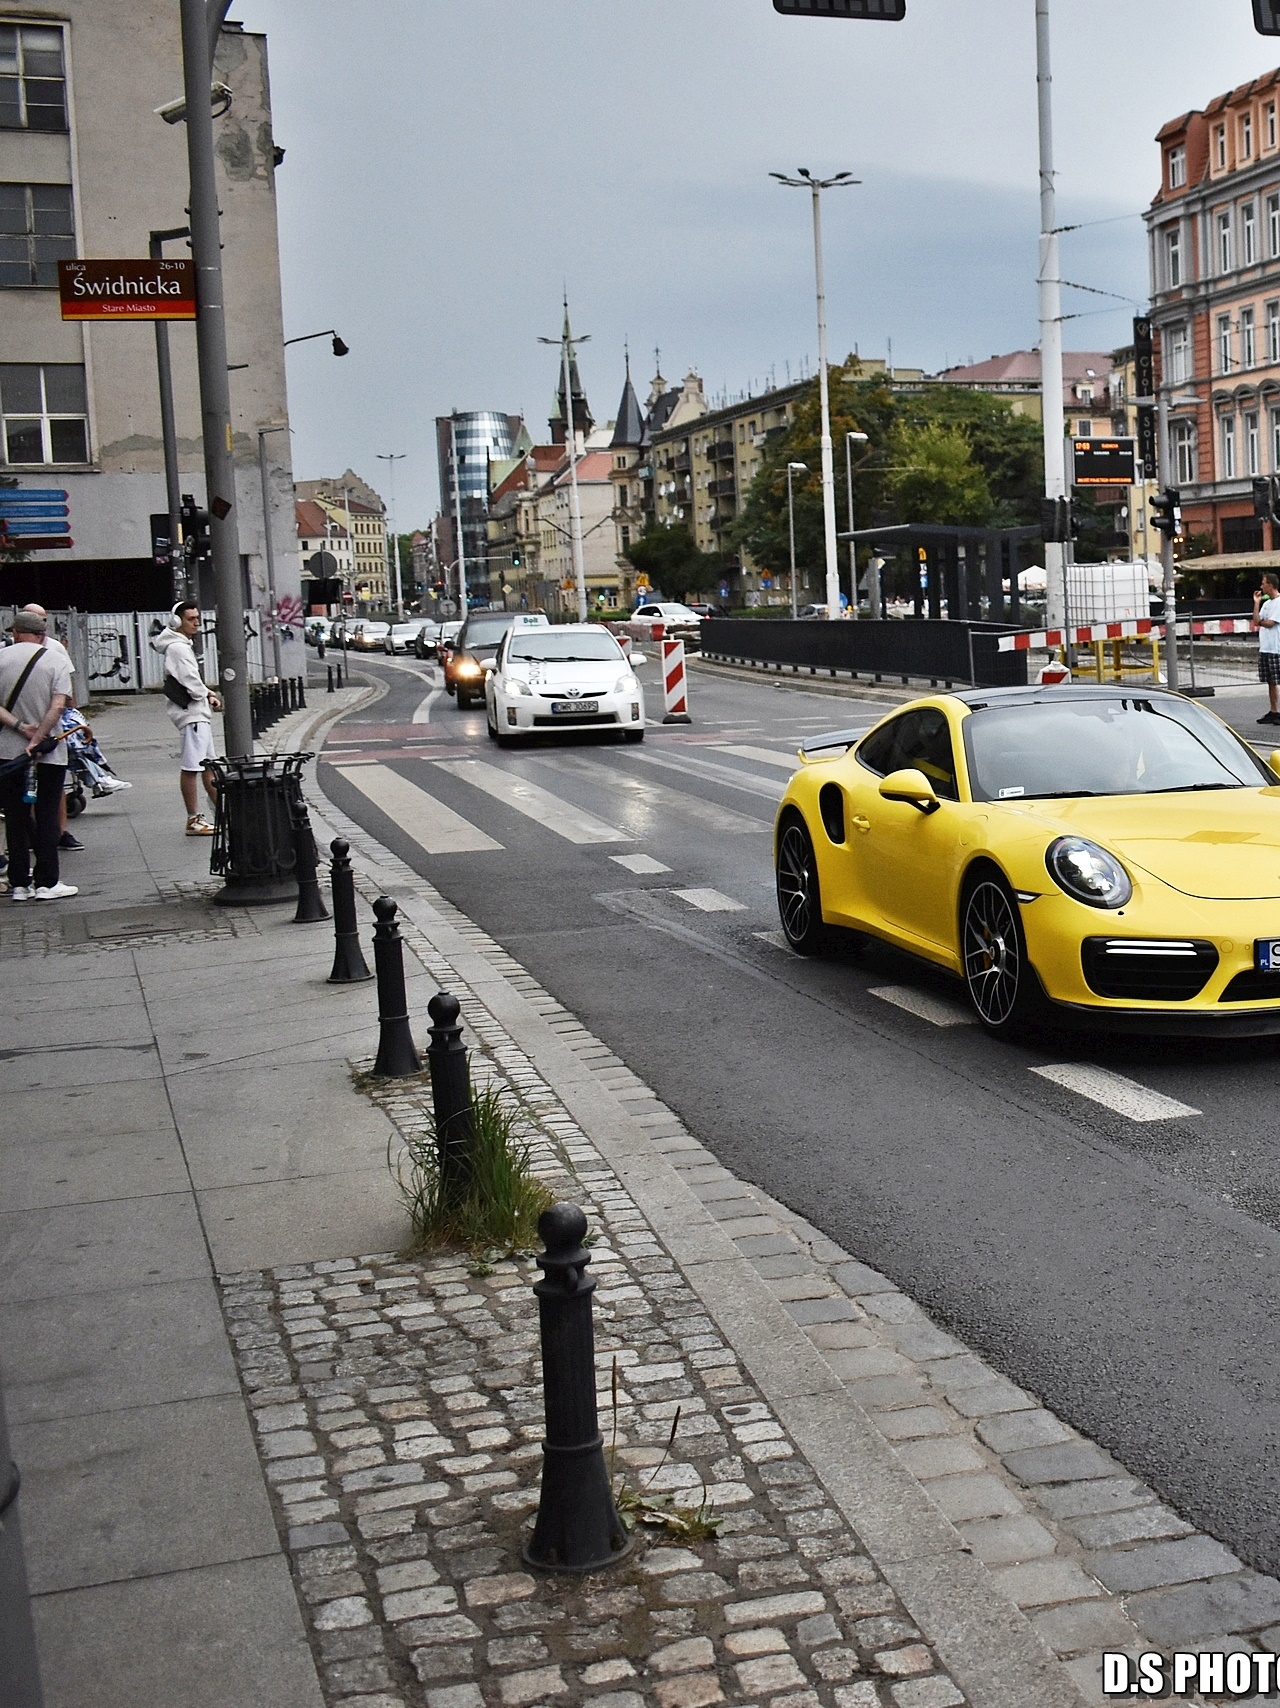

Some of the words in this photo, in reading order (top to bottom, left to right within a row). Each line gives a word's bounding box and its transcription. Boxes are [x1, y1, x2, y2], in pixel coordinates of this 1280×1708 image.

[66, 263, 87, 271] ulica
[160, 262, 185, 270] 26-10
[73, 272, 182, 296] Świdnicka
[102, 304, 125, 312] Stare
[126, 304, 156, 312] Miasto
[523, 616, 538, 625] Bolt
